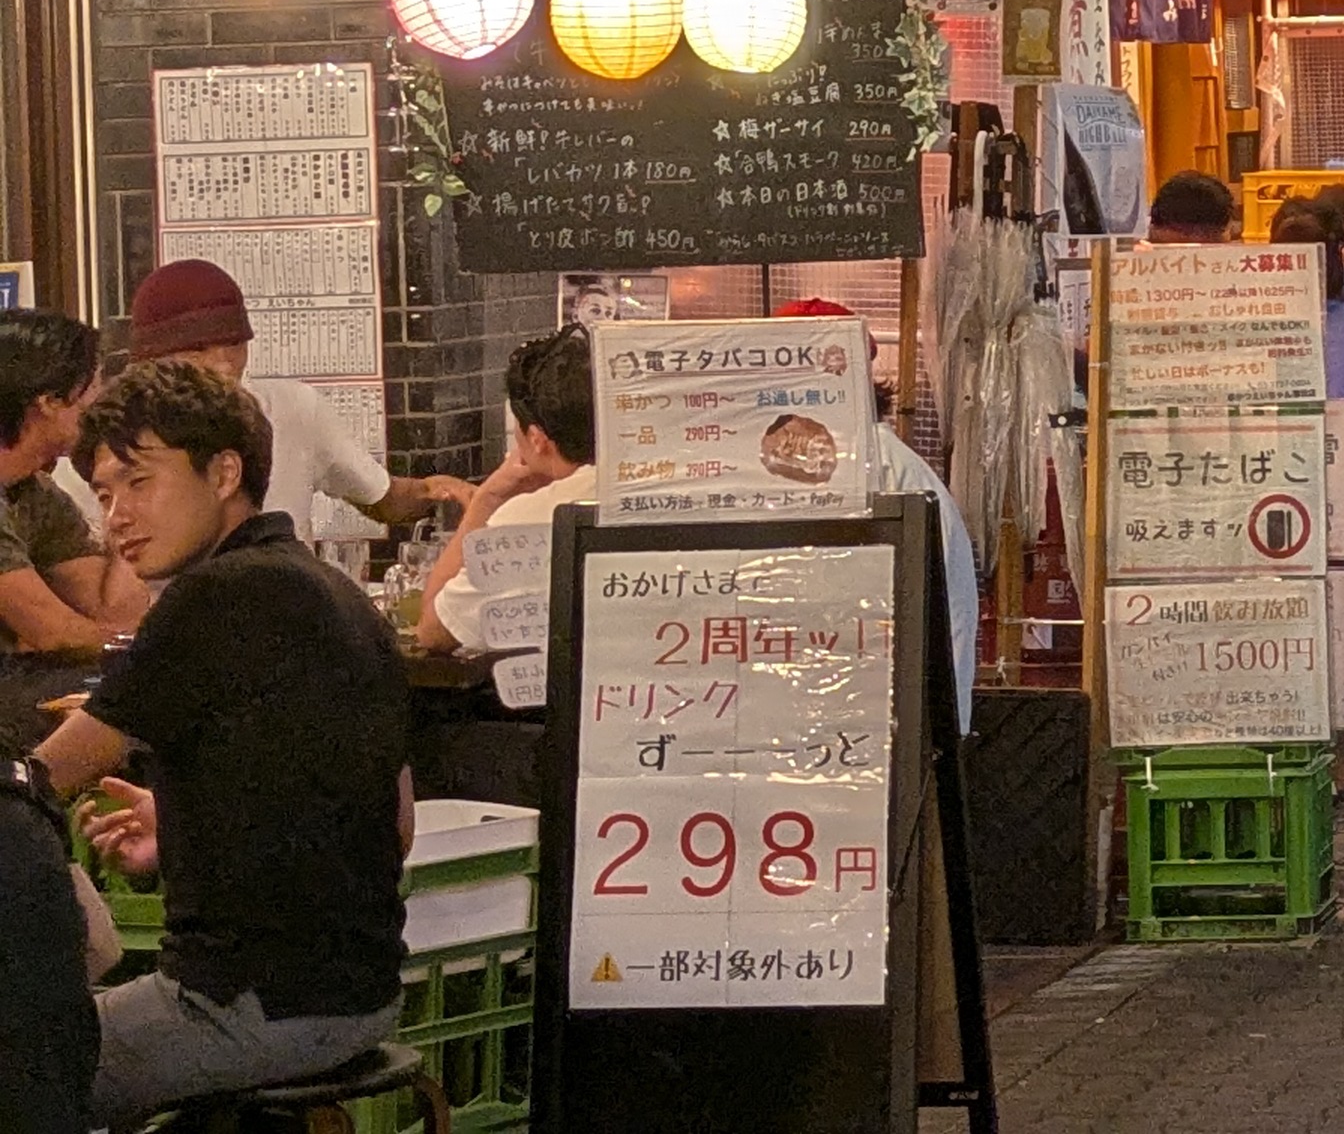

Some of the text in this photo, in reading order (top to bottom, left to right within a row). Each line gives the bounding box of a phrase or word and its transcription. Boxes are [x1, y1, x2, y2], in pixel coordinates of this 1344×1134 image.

[851, 43, 886, 59] 350
[643, 345, 816, 372] 電子タバコOK
[1117, 448, 1311, 489] 電子たばこ
[1196, 636, 1316, 673] 1500円
[593, 680, 740, 723] ドリンク
[592, 809, 879, 898] 298円
[626, 948, 856, 984] 一部対象外あり
